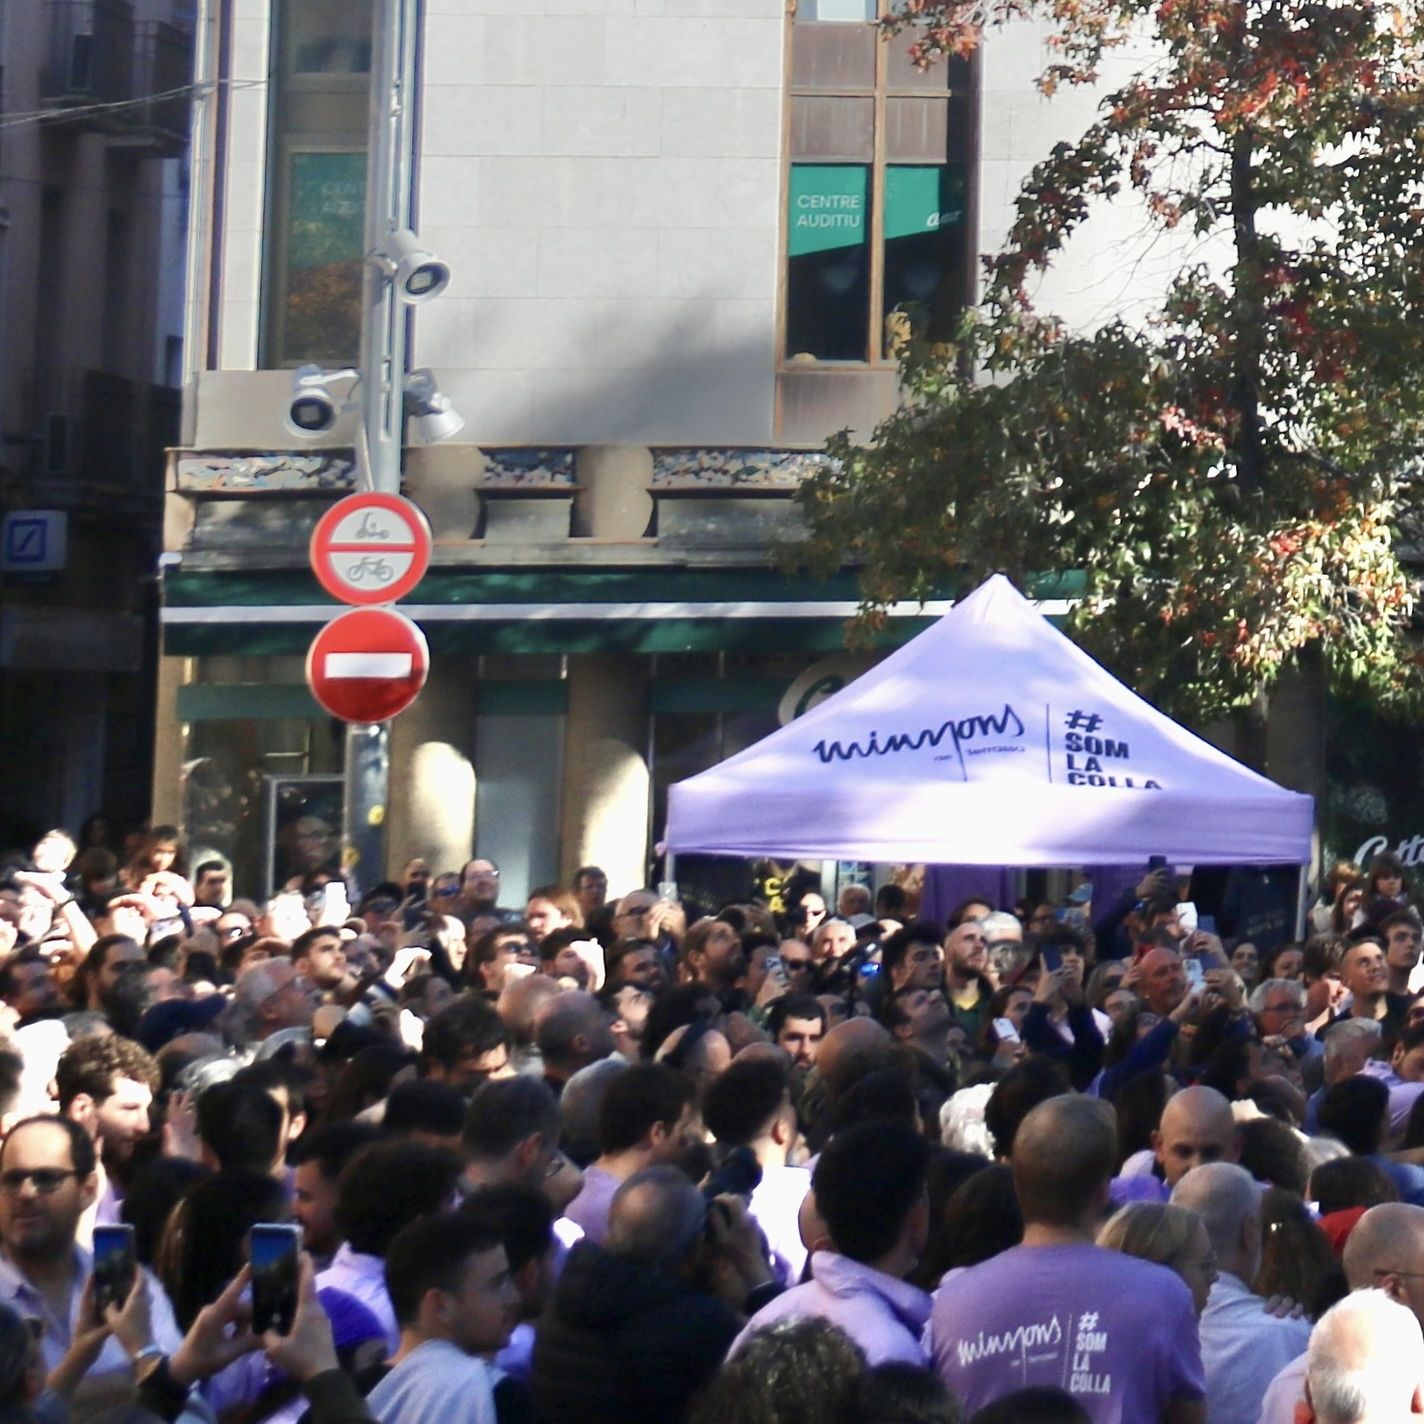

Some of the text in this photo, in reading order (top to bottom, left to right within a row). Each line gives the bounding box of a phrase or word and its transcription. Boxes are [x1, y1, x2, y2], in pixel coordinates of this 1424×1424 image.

[797, 194, 860, 209] CENTRE
[796, 213, 861, 228] AUDITIU
[1064, 732, 1130, 759] SOM
[1066, 754, 1103, 773] LA
[1076, 1331, 1109, 1352] SOM
[1072, 1352, 1090, 1372] LA
[1069, 1373, 1112, 1395] COLLA
